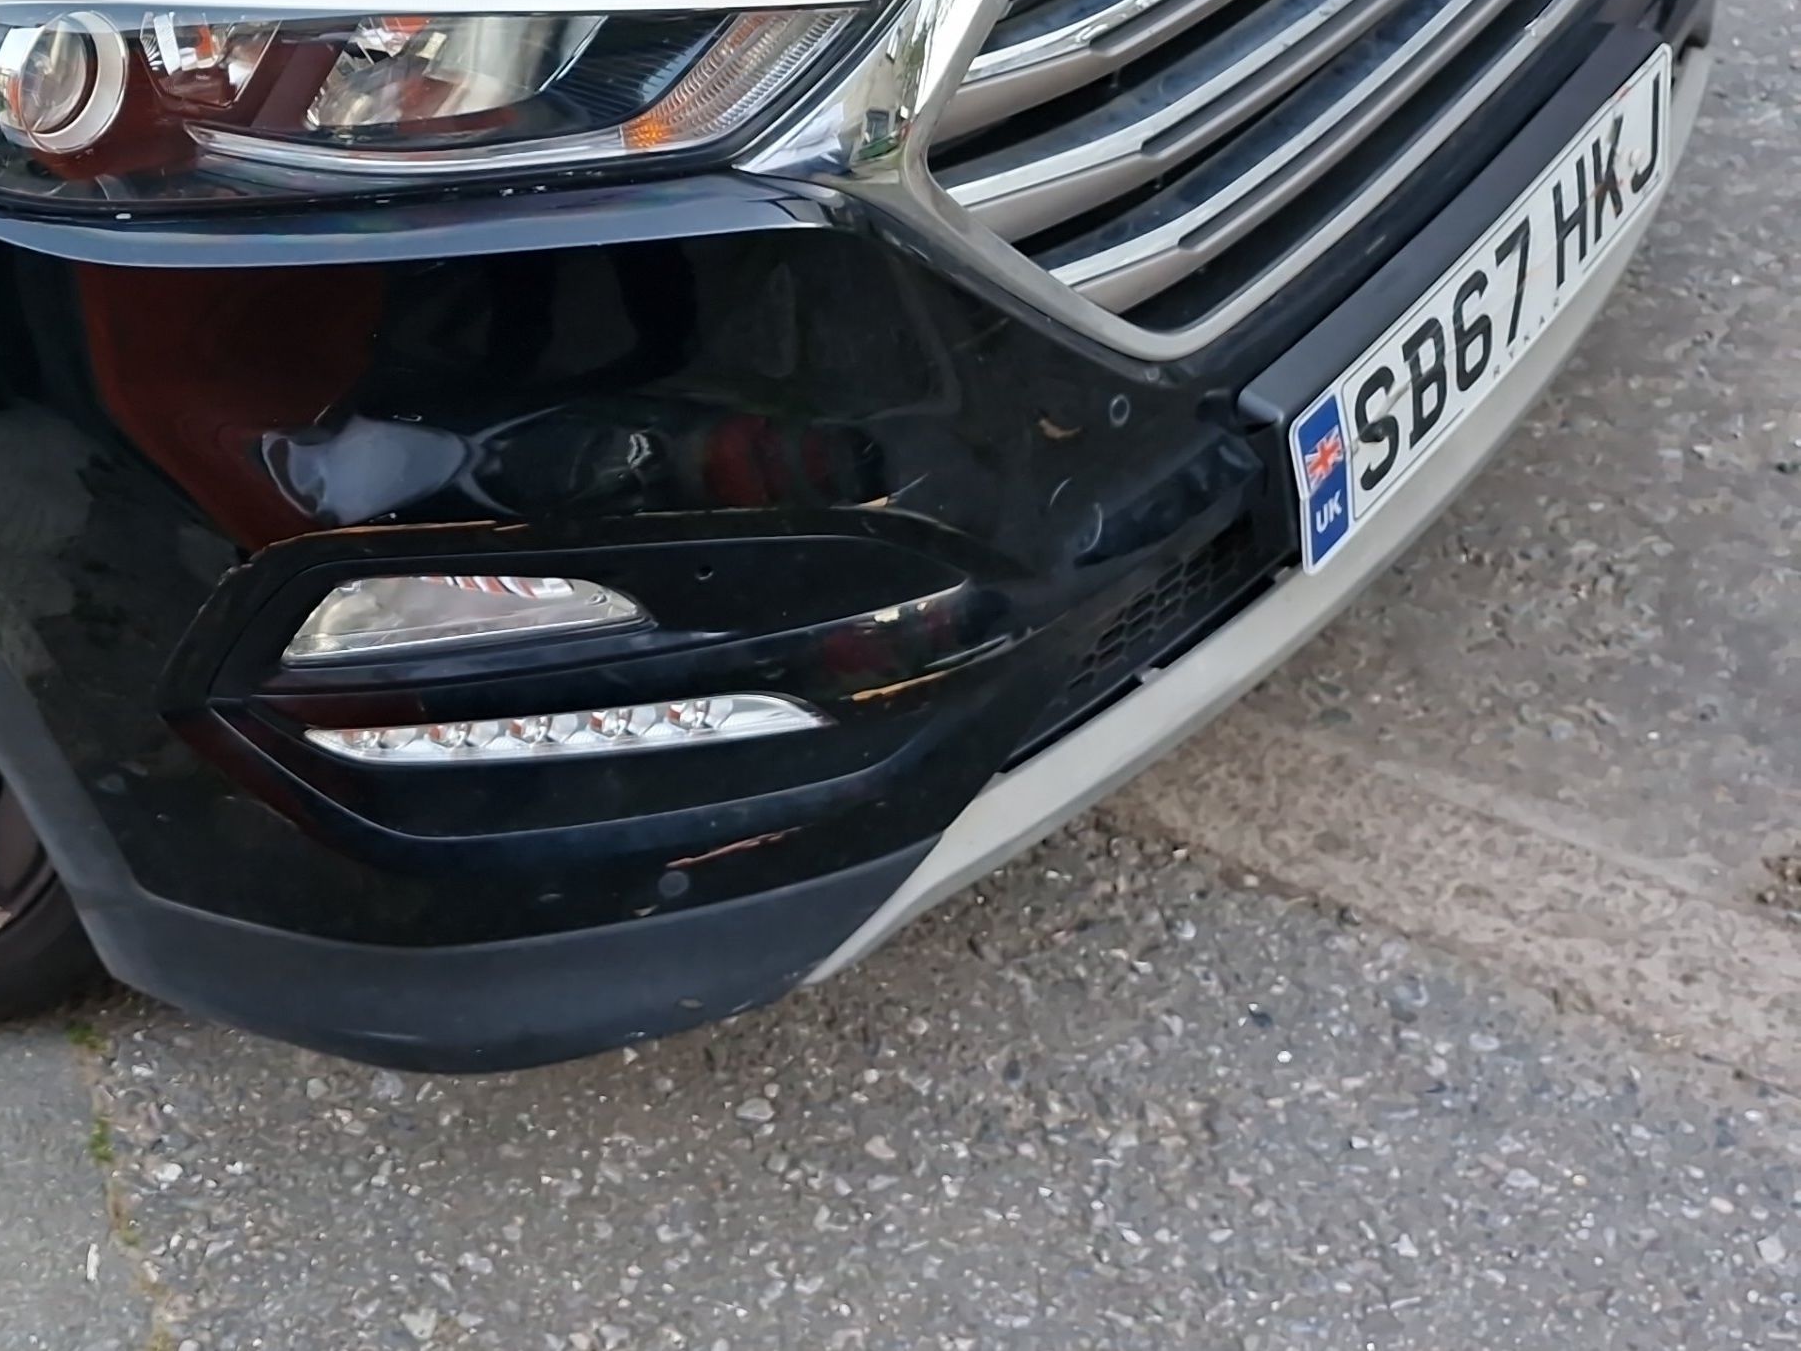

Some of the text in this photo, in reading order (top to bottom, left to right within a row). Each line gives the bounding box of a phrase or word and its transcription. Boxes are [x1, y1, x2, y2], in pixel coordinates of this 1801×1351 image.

[1354, 216, 1531, 491] SB67
[1551, 71, 1661, 290] HKJ
[1315, 489, 1343, 534] UK
